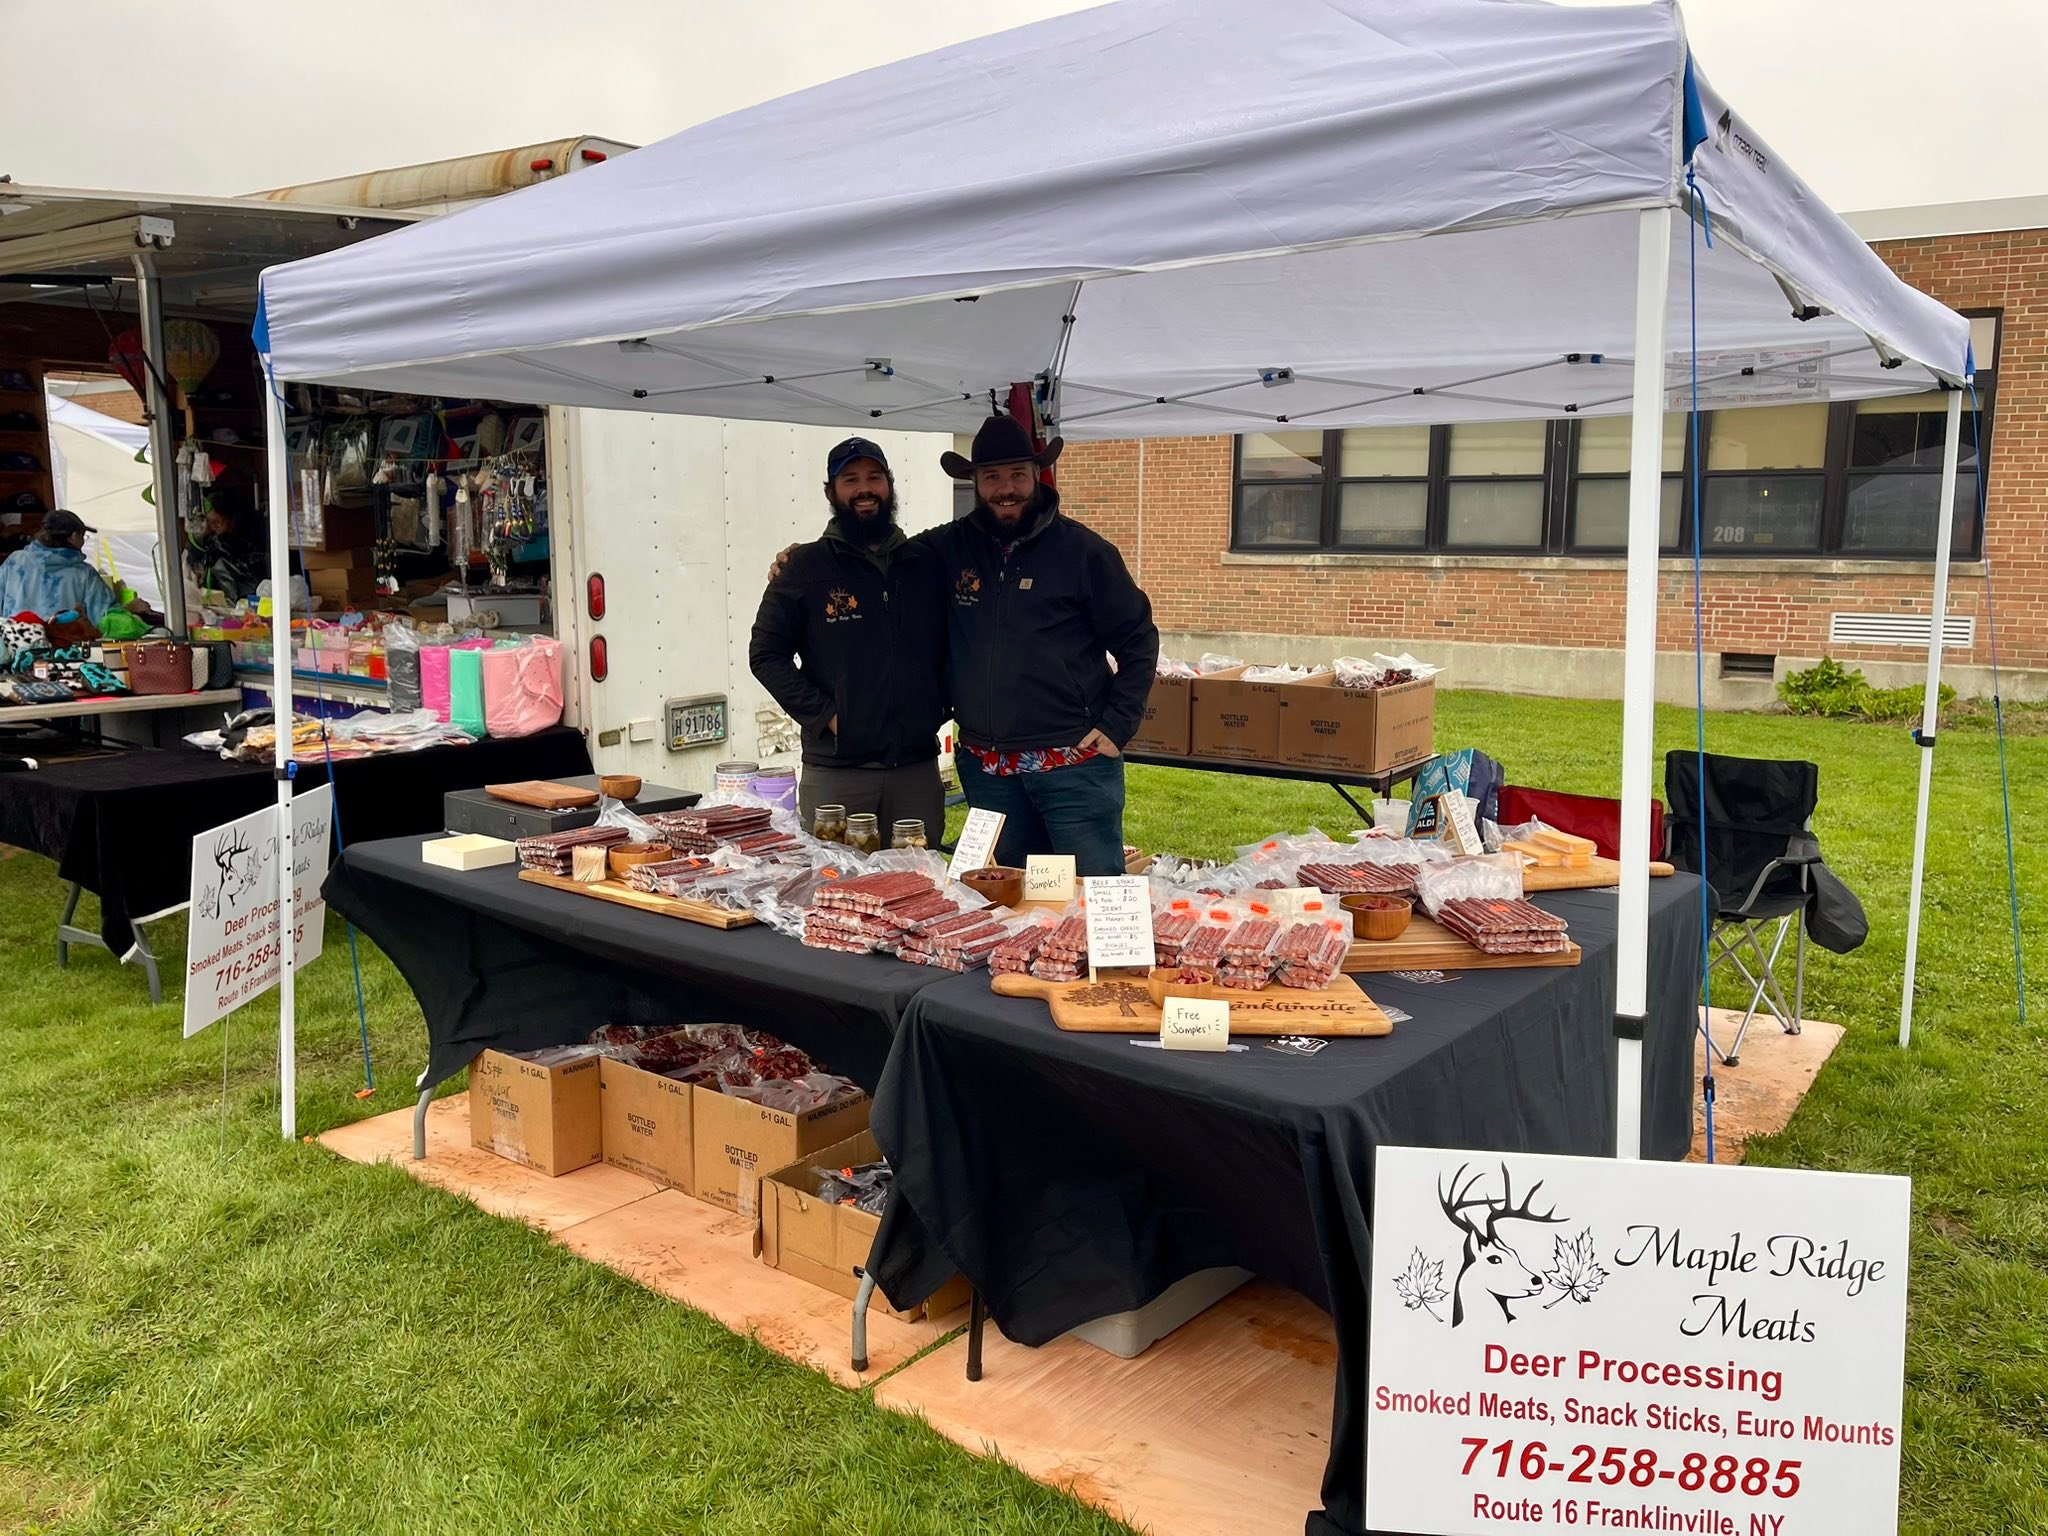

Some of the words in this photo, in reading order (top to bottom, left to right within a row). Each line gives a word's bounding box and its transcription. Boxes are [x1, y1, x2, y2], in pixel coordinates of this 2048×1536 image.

[1713, 526, 1745, 543] 208
[1220, 713, 1249, 721] BOTTLED
[1223, 720, 1245, 728] WATER
[1310, 719, 1340, 729] BOTTLED
[1313, 727, 1337, 735] WATER
[1416, 819, 1435, 829] ALDI
[1030, 865, 1050, 875] Free
[1027, 874, 1061, 890] Samples!
[1092, 879, 1109, 887] BEEF
[224, 916, 247, 937] Deer
[190, 946, 221, 976] Smoked
[246, 926, 267, 947] Snack
[218, 992, 239, 1011] Route
[240, 984, 249, 997] 16
[1177, 1008, 1200, 1020] Free
[1229, 1002, 1356, 1012] anklinville
[1171, 1022, 1211, 1036] Samples!
[657, 1080, 667, 1091] 6-1
[492, 1097, 520, 1113] BOTTLED
[807, 1105, 839, 1123] WARNING:
[839, 1101, 849, 1111] DO
[850, 1096, 862, 1108] NOT
[627, 1112, 657, 1130] BOTTLED
[761, 1110, 772, 1122] 6-1
[774, 1114, 792, 1128] GAL.
[631, 1123, 654, 1138] WATER
[725, 1144, 758, 1163] BOTTLED
[729, 1155, 755, 1172] WATER
[1614, 1225, 1758, 1286] Maple
[1767, 1235, 1886, 1297] Ridge
[1680, 1294, 1816, 1343] Meats
[1484, 1344, 1567, 1377] Deer
[1579, 1350, 1782, 1401] Processing
[1375, 1386, 1471, 1416] Smoked
[1479, 1392, 1556, 1426] Meats,
[1564, 1398, 1639, 1427] Snack
[1646, 1403, 1728, 1438] Sticks,
[1737, 1410, 1795, 1439] Euro
[1803, 1415, 1895, 1446] Mounts
[1461, 1437, 1802, 1498] 716-258-8885
[1473, 1493, 1544, 1522] Route
[1552, 1499, 1578, 1524] 16
[1750, 1513, 1785, 1536] NY
